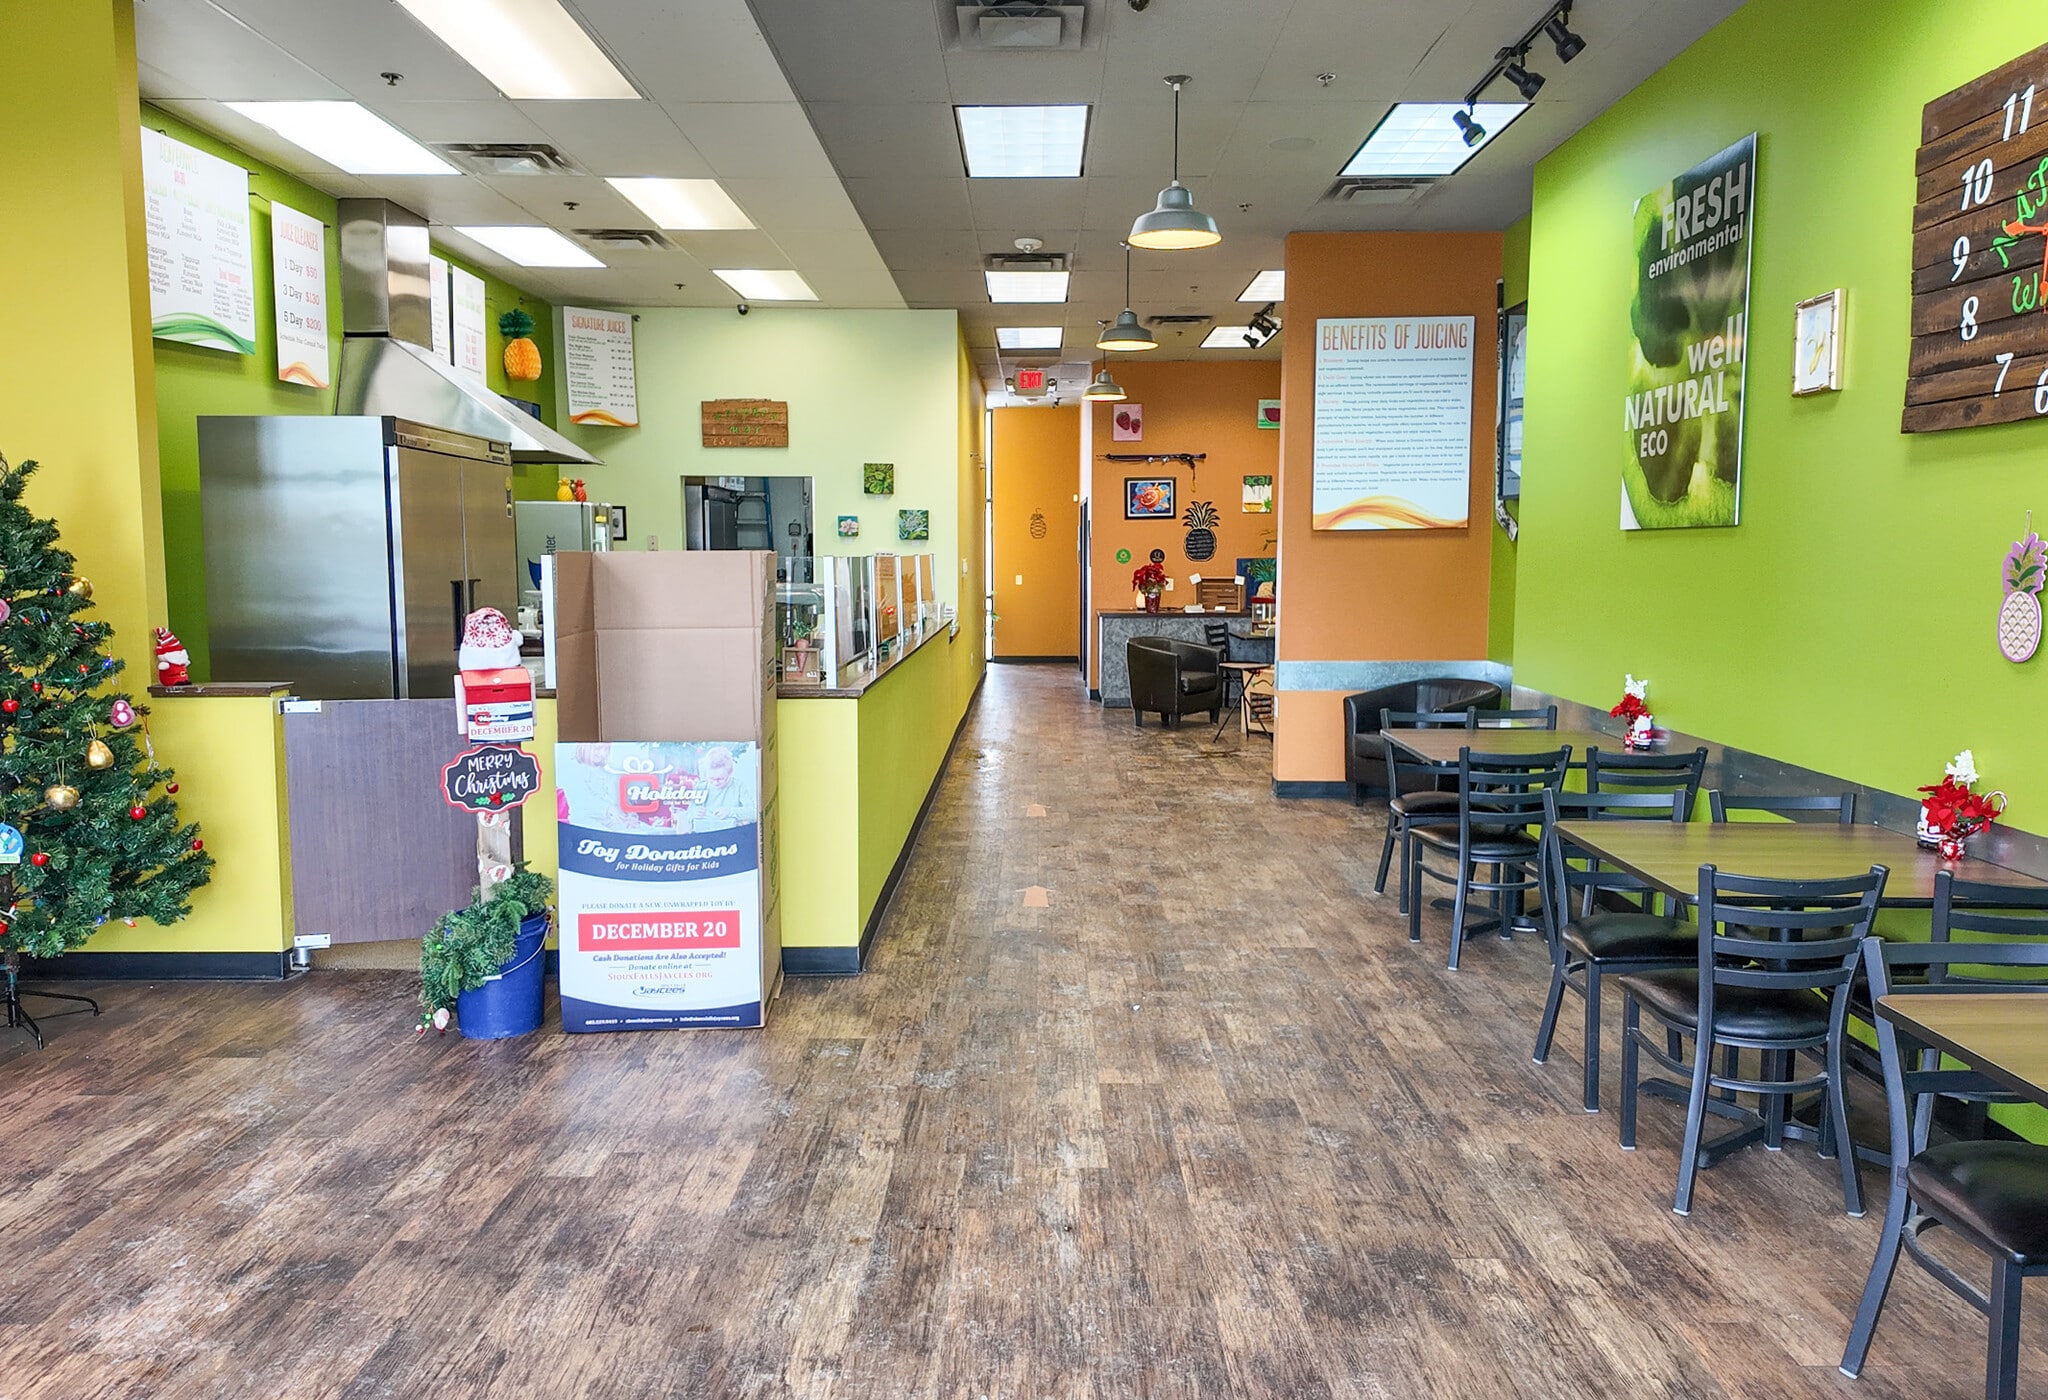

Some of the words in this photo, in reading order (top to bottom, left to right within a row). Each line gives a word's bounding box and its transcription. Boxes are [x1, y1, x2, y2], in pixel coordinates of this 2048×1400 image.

[2001, 84, 2036, 142] 11
[1961, 158, 1994, 211] 10
[1660, 160, 1748, 251] FRESH
[1648, 214, 1744, 279] environmental
[289, 259, 303, 276] Day
[1952, 236, 1970, 282] 9
[282, 284, 288, 296] 3
[289, 285, 303, 303] Day
[290, 312, 303, 330] Day
[305, 316, 321, 331] $200
[571, 315, 605, 331] SIGNATURE
[607, 319, 626, 334] JUICES
[1960, 295, 1980, 341] 8
[1322, 324, 1387, 351] BENEFITS
[1394, 323, 1411, 349] OF
[1415, 322, 1468, 349] JUICING
[1688, 312, 1742, 374] well
[1020, 371, 1043, 388] EXIT
[1993, 352, 2014, 398] 7
[1624, 371, 1729, 432] NATURAL
[1640, 432, 1669, 458] ECO
[471, 726, 519, 736] DECEMBER
[468, 752, 514, 773] MERRY
[455, 770, 531, 798] Christmas
[627, 785, 708, 805] Holiday
[578, 839, 620, 863] Toy
[625, 844, 738, 862] Donations
[615, 862, 629, 871] for
[631, 862, 663, 873] Holiday
[665, 861, 685, 872] Gifts
[686, 862, 700, 871] for
[702, 860, 719, 870] Kids
[592, 922, 699, 940] DECEMBER
[703, 921, 727, 937] 20
[593, 954, 612, 962] Cash
[613, 953, 654, 961] Donations
[655, 953, 669, 961] Are
[689, 951, 727, 961] Accepted!
[628, 963, 657, 971] Donate
